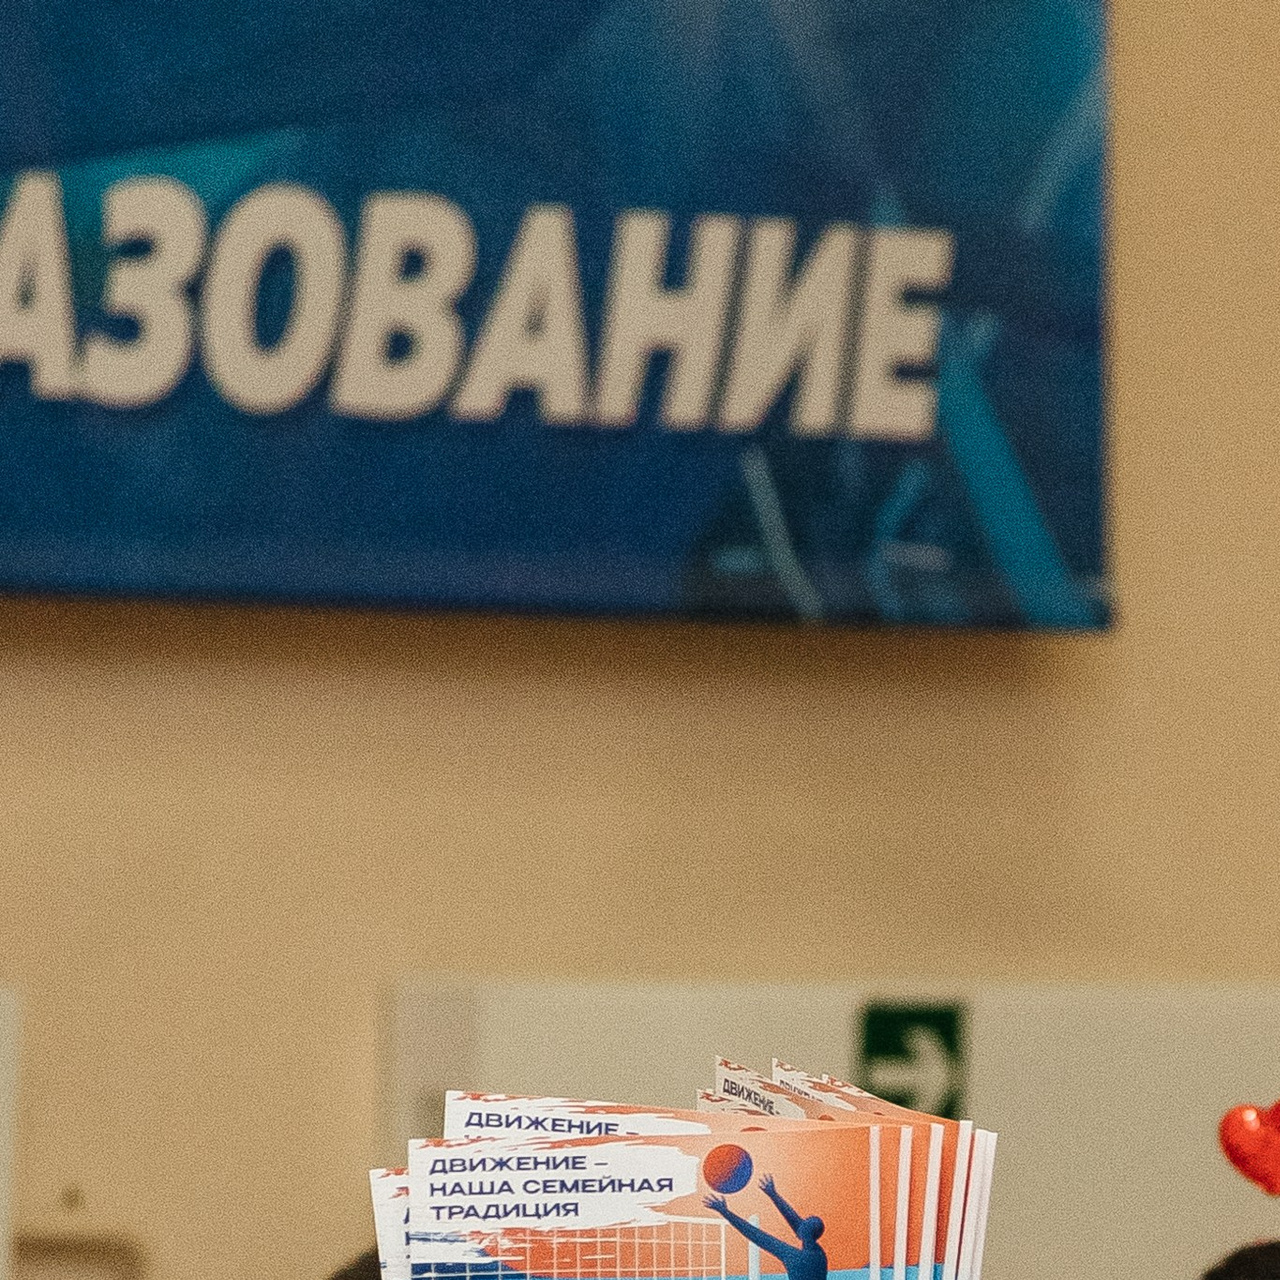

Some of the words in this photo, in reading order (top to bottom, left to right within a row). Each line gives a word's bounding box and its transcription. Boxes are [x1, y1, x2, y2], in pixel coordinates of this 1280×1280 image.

[0, 170, 956, 440] АЗОВАНИЕ
[465, 1112, 620, 1136] ДВИЖЕНИЕ
[429, 1155, 588, 1176] ДВИЖЕНИЕ
[429, 1181, 515, 1198] НАША
[522, 1175, 674, 1195] СЕМЕЙНАЯ
[429, 1202, 580, 1220] ТРАДИЦИЯ
